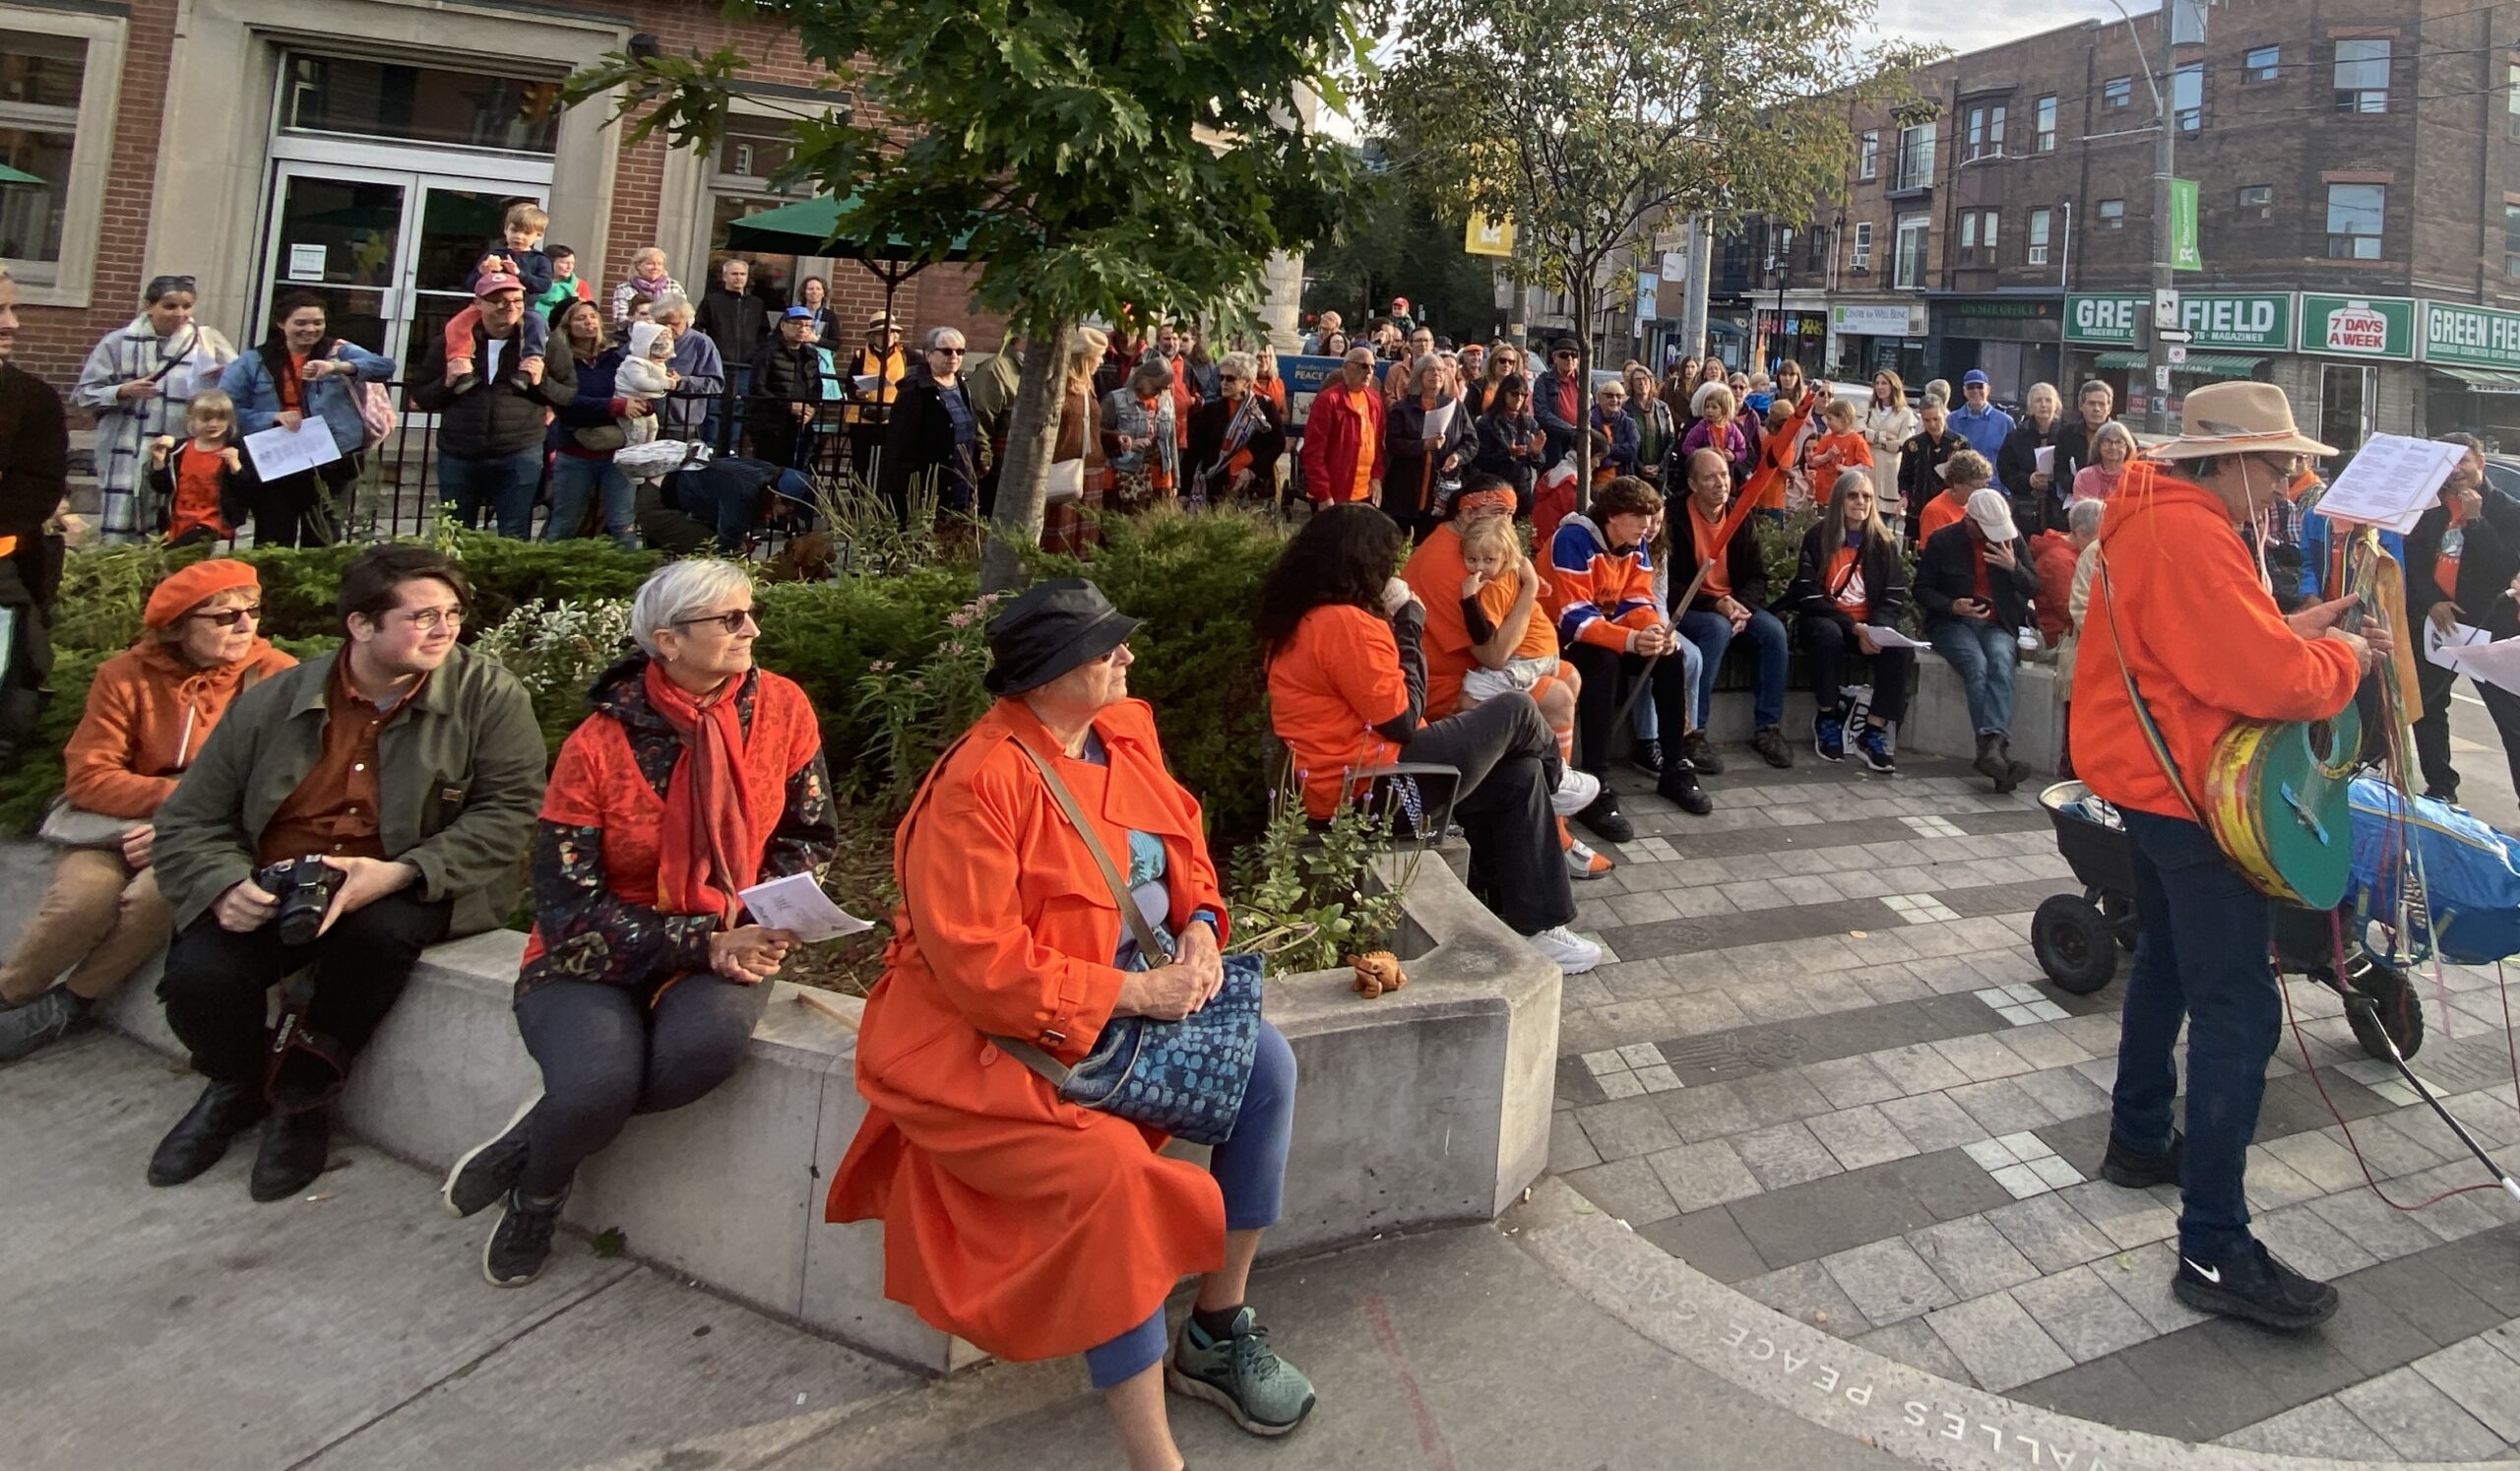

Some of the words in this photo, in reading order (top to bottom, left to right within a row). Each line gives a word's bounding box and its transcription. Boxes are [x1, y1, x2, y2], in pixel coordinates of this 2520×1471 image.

[2182, 299, 2275, 332] FIELD
[2082, 328, 2124, 338] GROCERIES
[2331, 318, 2341, 331] 7
[2345, 318, 2384, 333] DAYS
[2429, 308, 2488, 348] GREEN
[2491, 316, 2520, 352] FIE
[2211, 332, 2264, 343] MAGAZINES
[2329, 333, 2340, 346] A
[2343, 334, 2383, 348] WEEK
[1295, 370, 1323, 380] PEACE
[1720, 1319, 1874, 1406] PEACE
